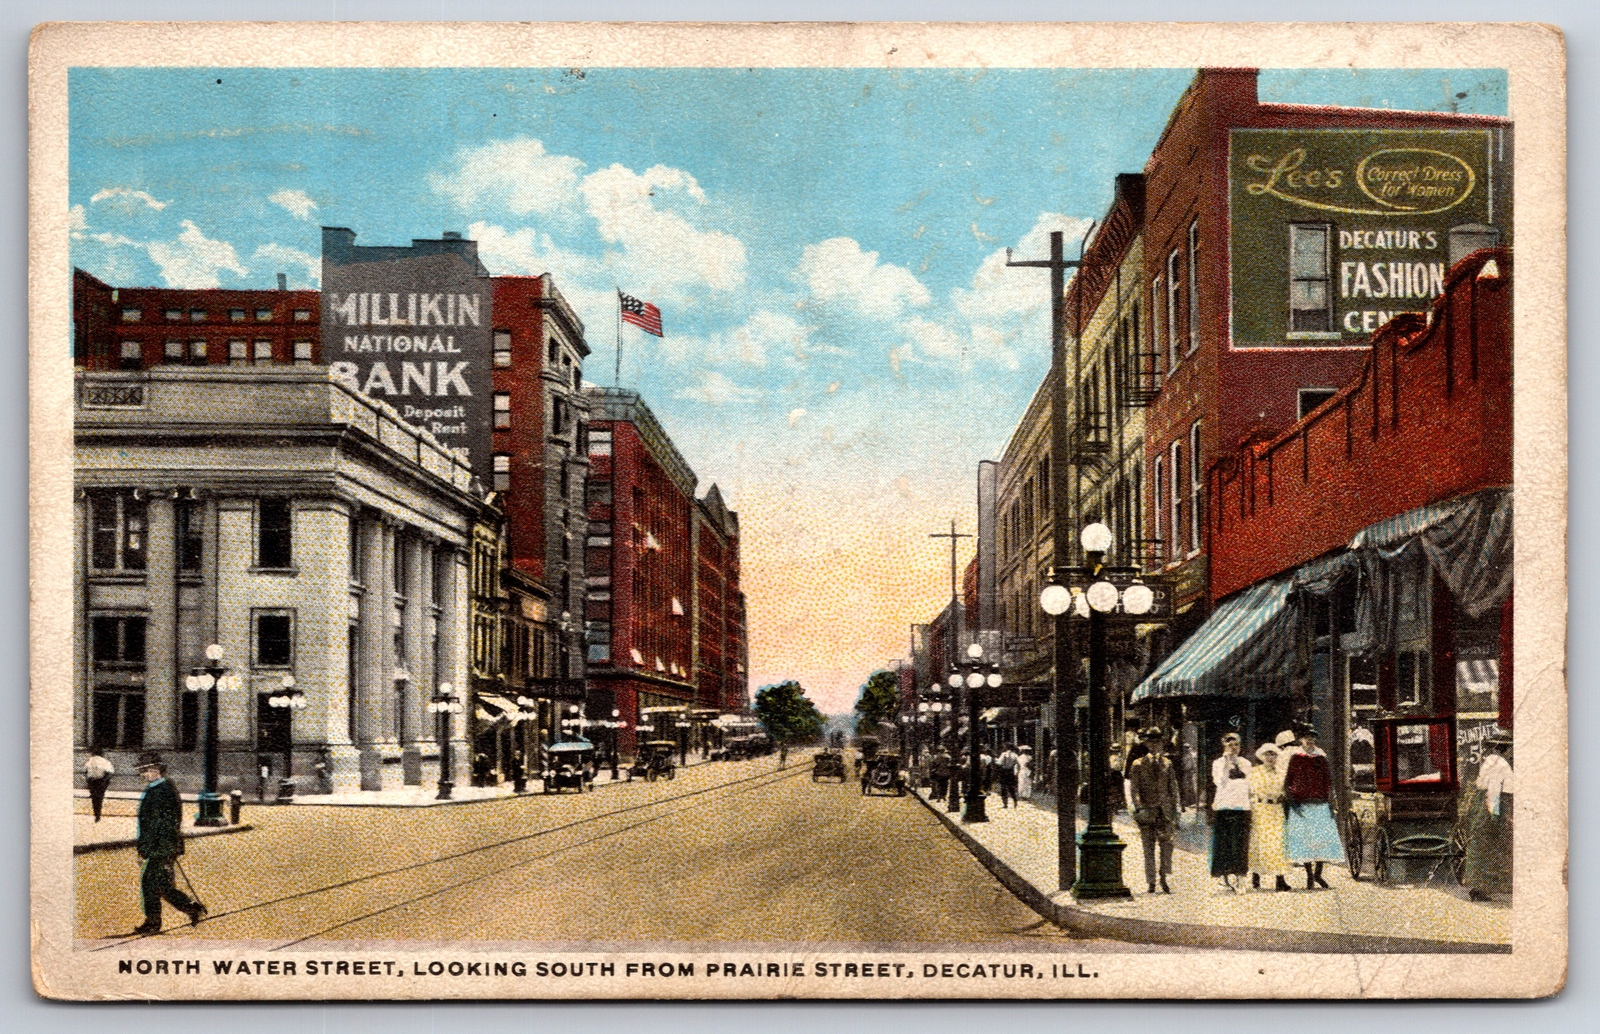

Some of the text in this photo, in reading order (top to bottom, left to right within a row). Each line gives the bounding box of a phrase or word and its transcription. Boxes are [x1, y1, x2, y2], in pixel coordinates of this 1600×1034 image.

[1246, 148, 1344, 196] Lee's
[1367, 165, 1463, 181] Correct Dress
[1380, 181, 1455, 198] for Women
[1339, 229, 1439, 250] DECATUR'S
[1341, 261, 1445, 299] FASHION
[329, 292, 480, 326] MILLIKIN
[1343, 310, 1433, 333] CEN
[344, 334, 461, 353] NATIONAL
[329, 360, 473, 396] BANK
[404, 404, 466, 421] Deposit
[431, 421, 467, 434] Rent
